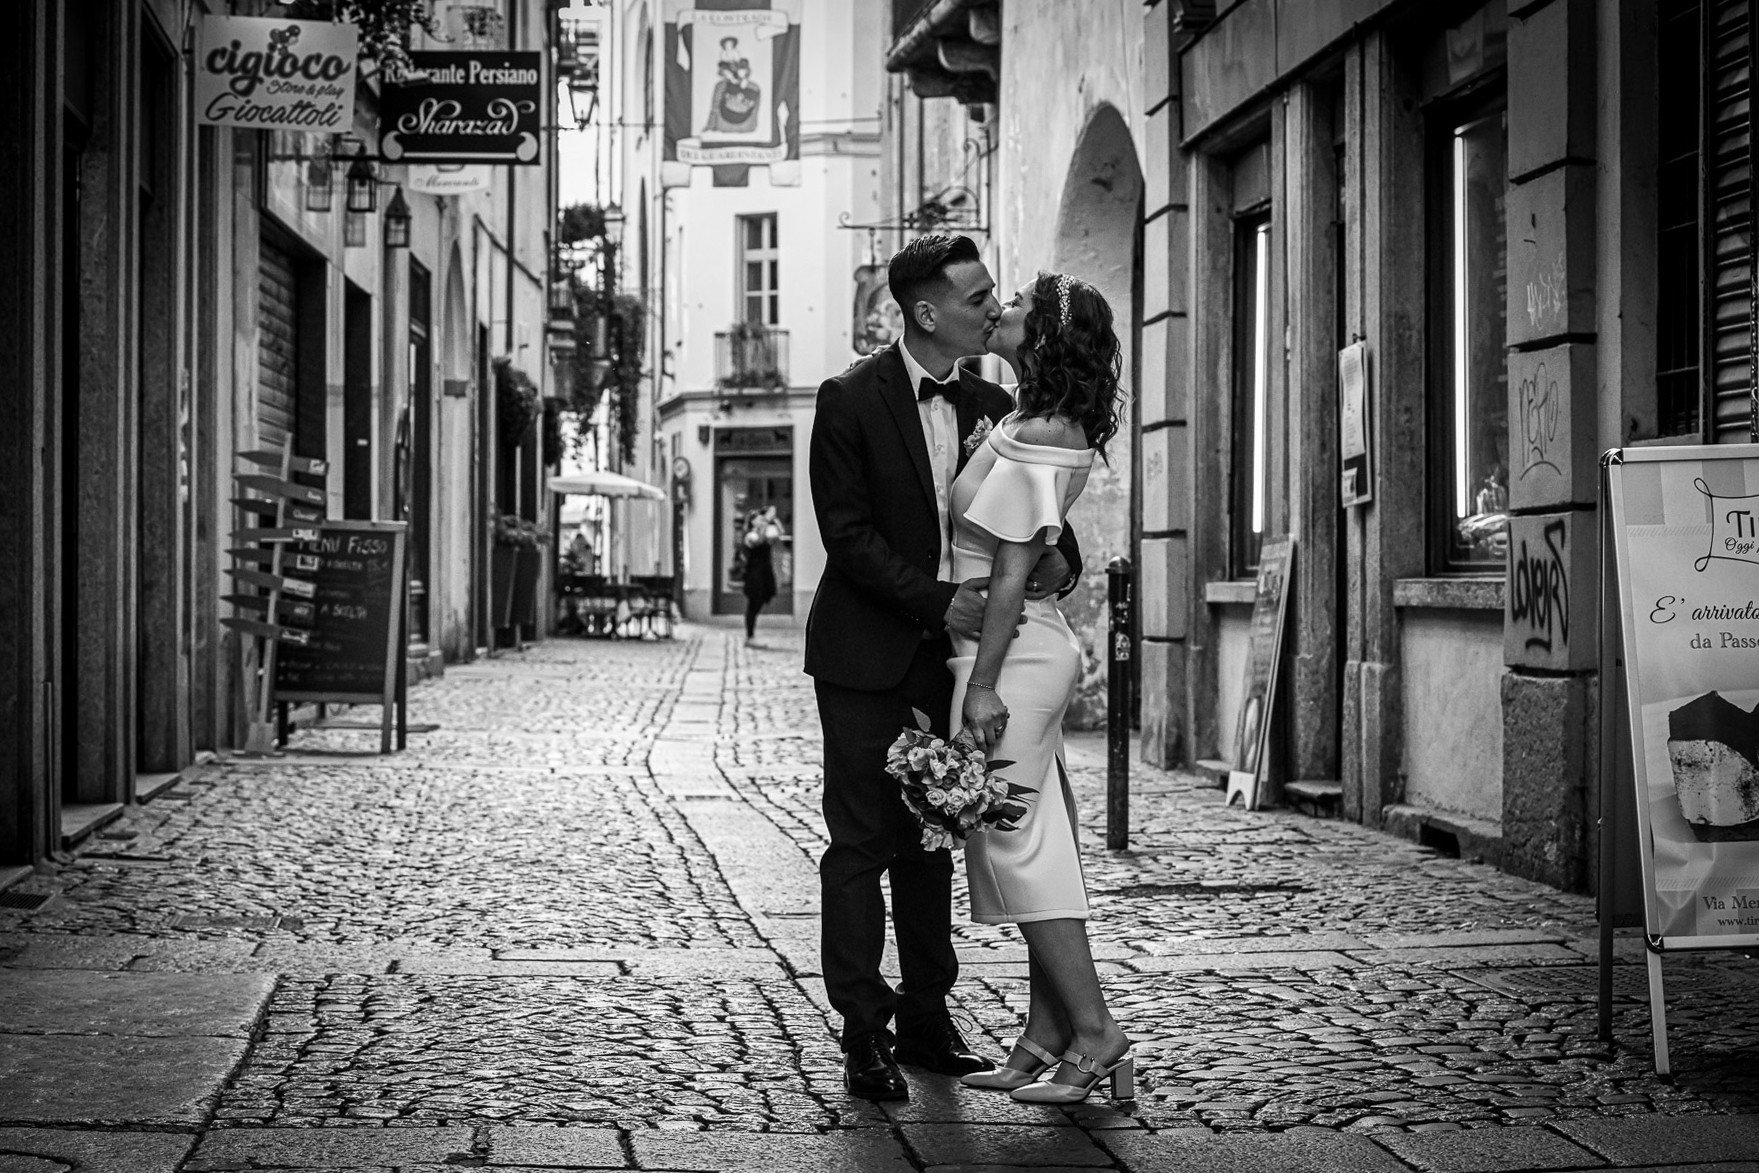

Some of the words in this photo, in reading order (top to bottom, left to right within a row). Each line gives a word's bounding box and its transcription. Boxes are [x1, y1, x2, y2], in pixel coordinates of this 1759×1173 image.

[206, 38, 351, 96] cigioco
[469, 60, 538, 85] Persiano
[205, 92, 344, 127] Giocattoli
[397, 98, 536, 135] Sharazad
[1726, 510, 1759, 538] TI
[1725, 537, 1755, 554] Oggi
[1692, 600, 1759, 620] arrivato
[1690, 633, 1712, 649] da
[1702, 896, 1725, 910] Via
